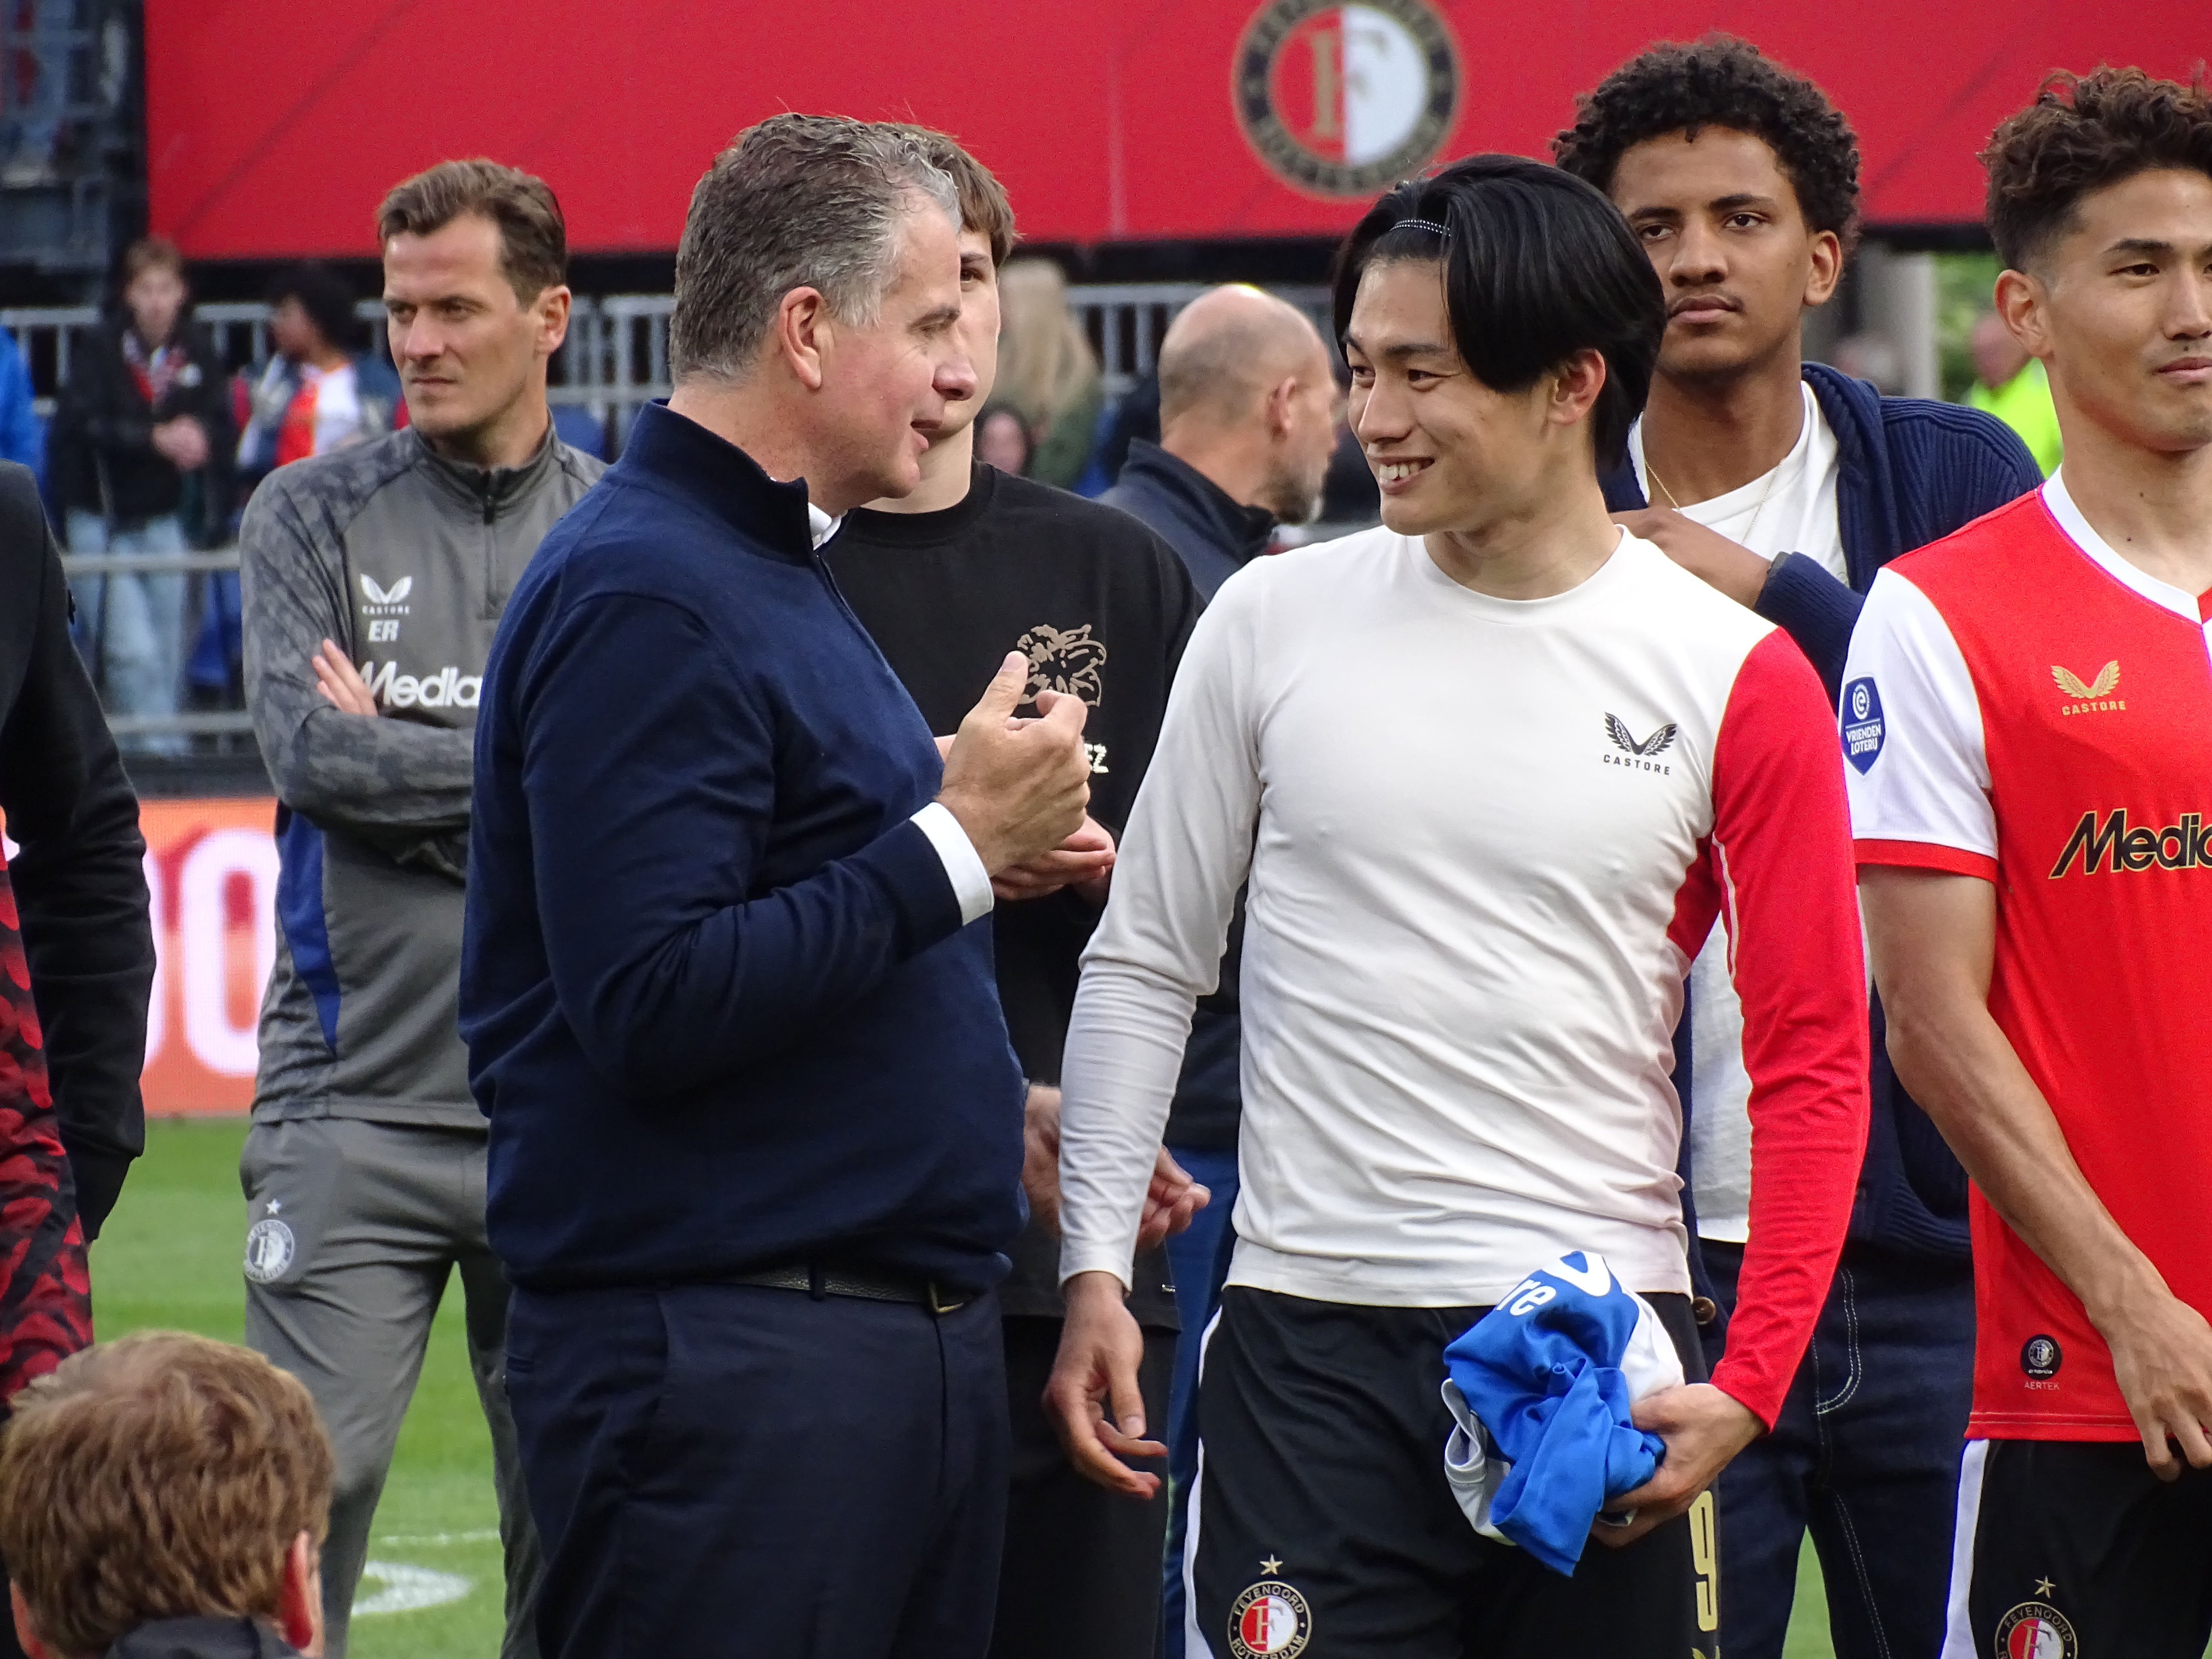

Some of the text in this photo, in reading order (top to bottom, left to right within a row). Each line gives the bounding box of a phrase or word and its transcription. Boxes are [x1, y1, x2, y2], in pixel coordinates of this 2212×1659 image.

[368, 619, 400, 642] ER
[2061, 700, 2127, 716] CASTORE
[1845, 724, 1881, 743] VRIENDEN
[1850, 737, 1877, 755] LOTERIJ
[1603, 754, 1670, 775] CASTORE
[1688, 1490, 1718, 1632] 9
[2004, 1605, 2072, 1642] FEYENOORD
